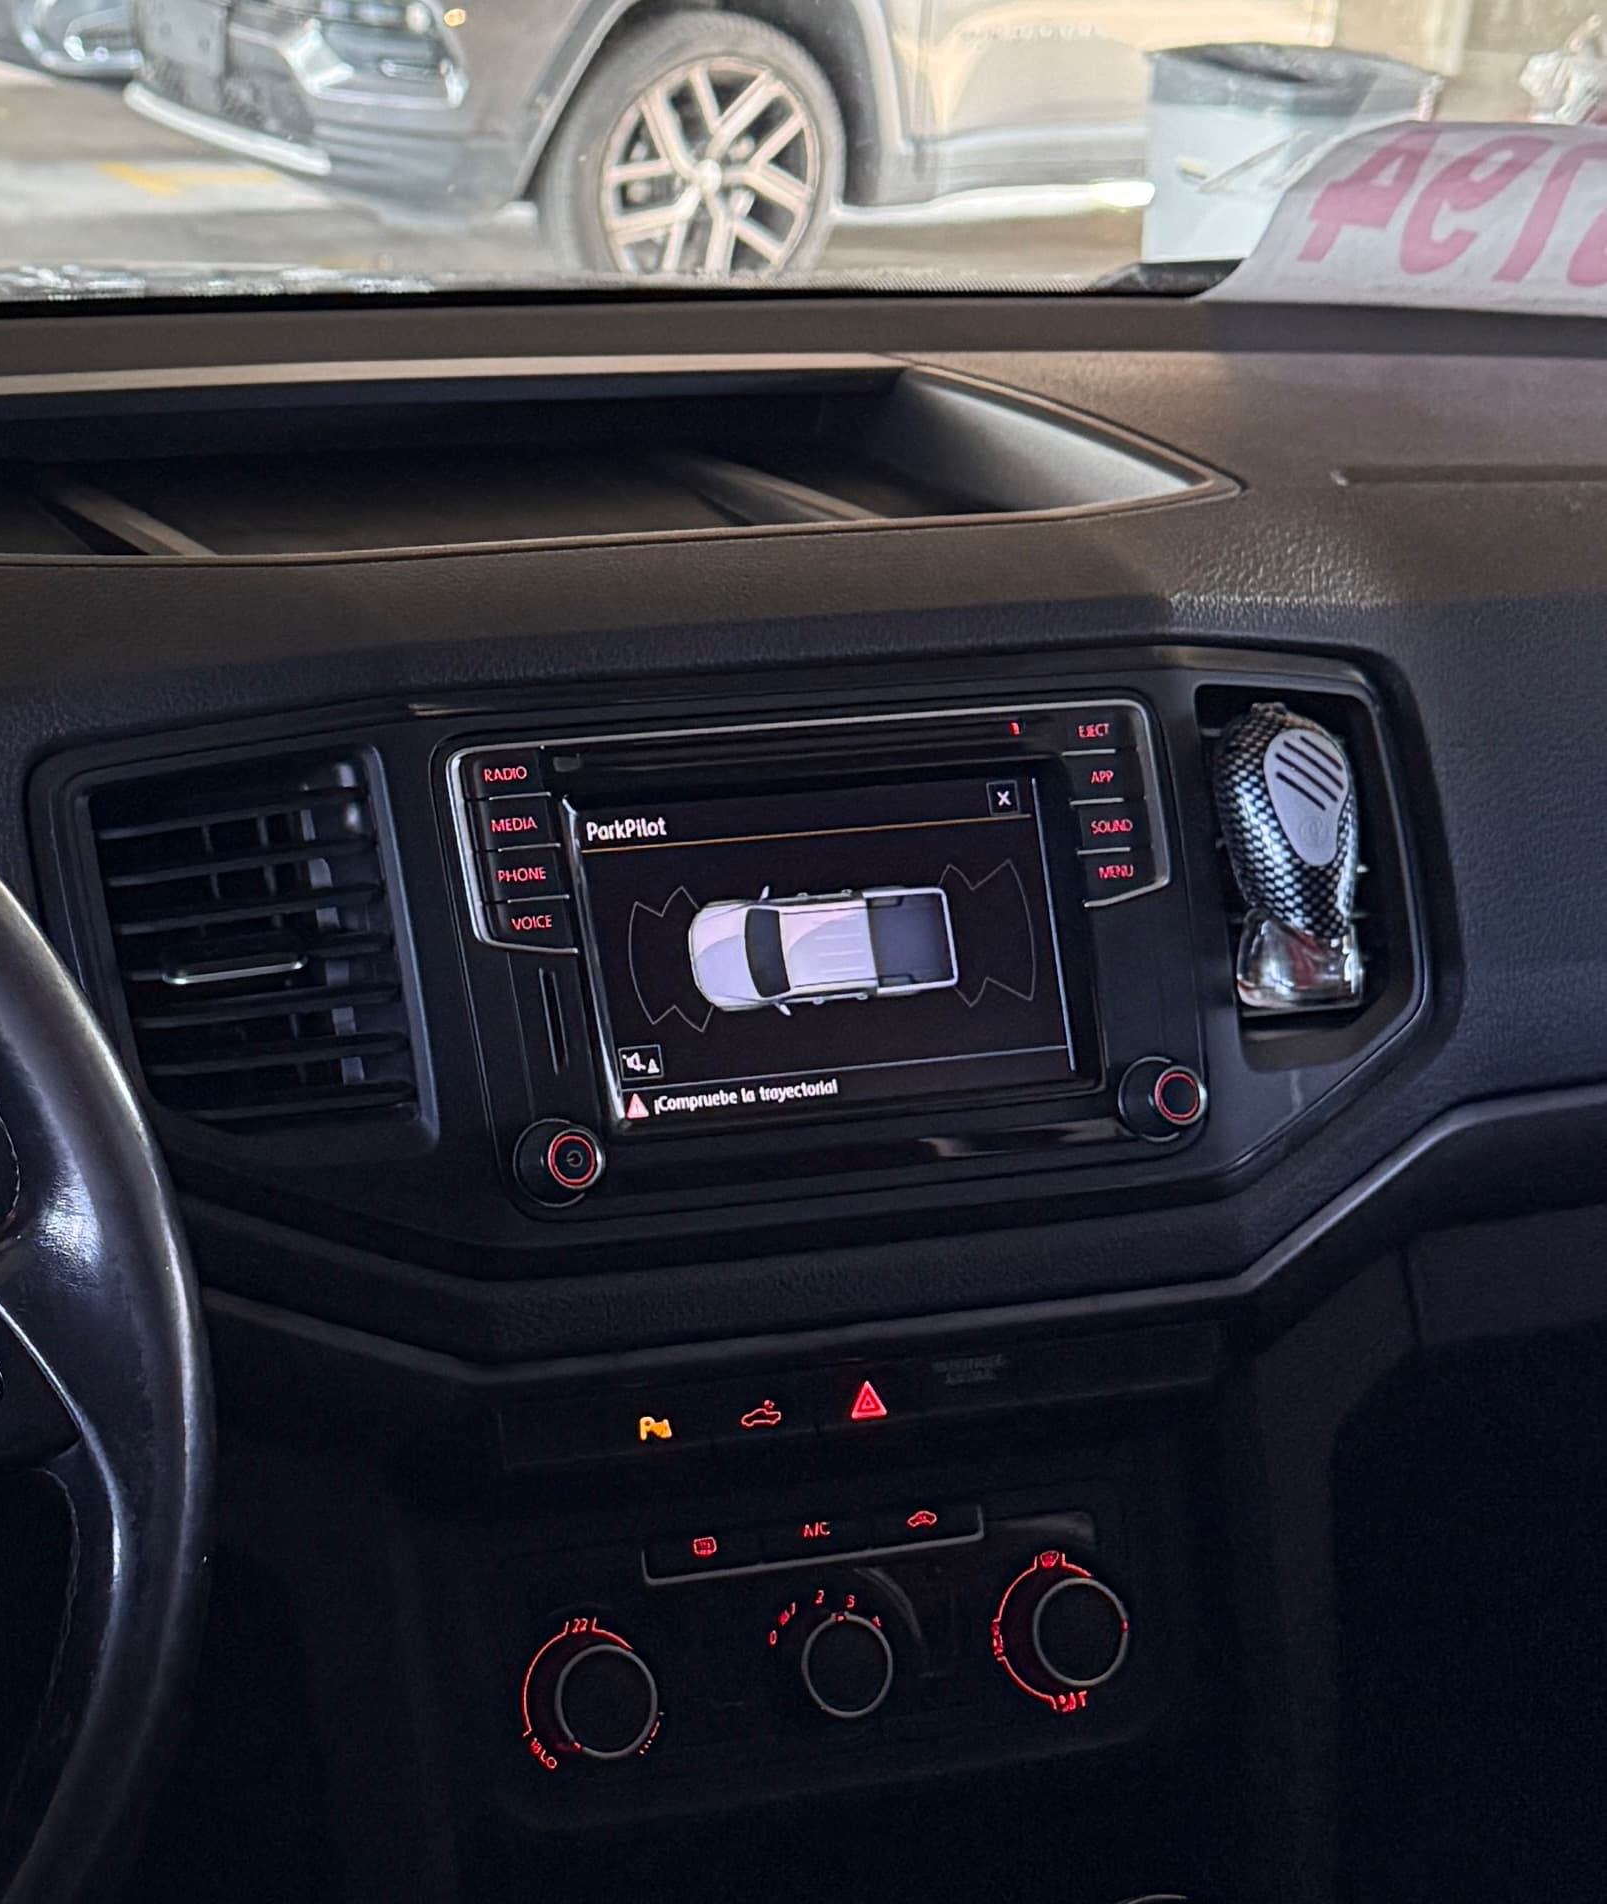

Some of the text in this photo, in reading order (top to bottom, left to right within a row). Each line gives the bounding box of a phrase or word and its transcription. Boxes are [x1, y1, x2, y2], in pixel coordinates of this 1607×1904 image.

[1077, 723, 1110, 739] EJECT
[483, 766, 528, 783] RADIO
[1090, 770, 1114, 784] APP
[490, 816, 538, 833] MEDIA
[586, 816, 667, 841] ParkPilot
[1090, 819, 1133, 835] SOUND
[497, 866, 547, 883] PHONE
[1098, 864, 1134, 879] MENU
[510, 914, 553, 930] VOICE
[654, 1089, 738, 1115] ¡Compruebe
[740, 1087, 756, 1104] la
[803, 1521, 830, 1537] A/C
[815, 1589, 825, 1604] 2
[571, 1617, 588, 1633] 22
